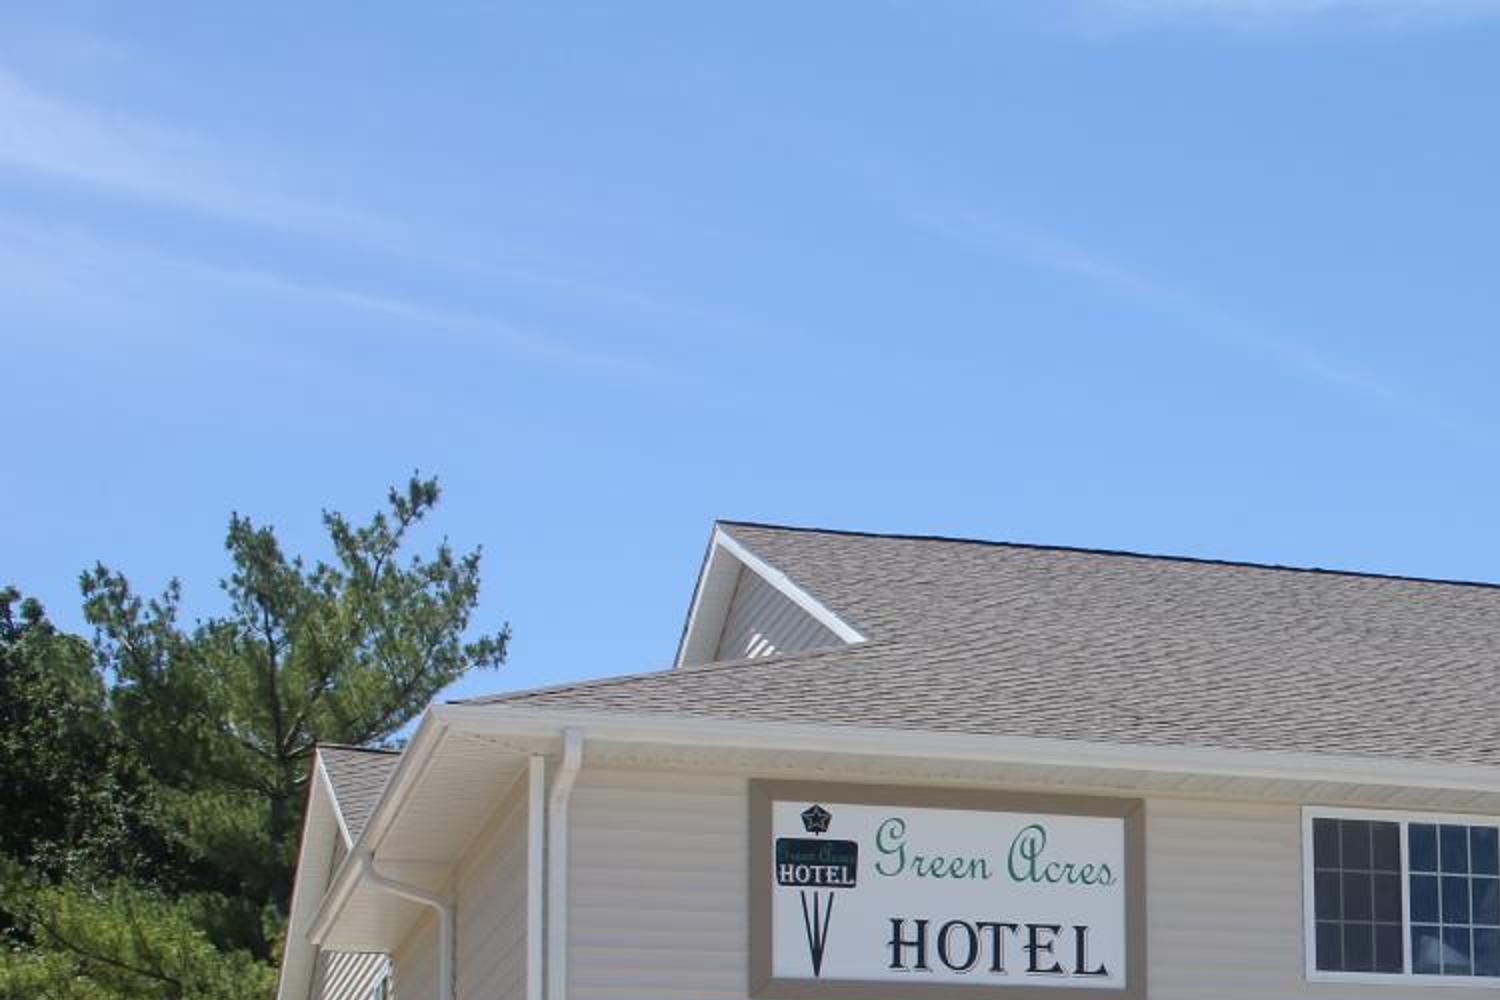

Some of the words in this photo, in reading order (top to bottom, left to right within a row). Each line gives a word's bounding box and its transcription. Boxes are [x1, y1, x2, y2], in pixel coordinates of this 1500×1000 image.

[779, 863, 855, 885] HOTEL
[875, 816, 992, 880] Green
[1007, 823, 1117, 886] Acres
[888, 916, 1113, 978] HOTEL
